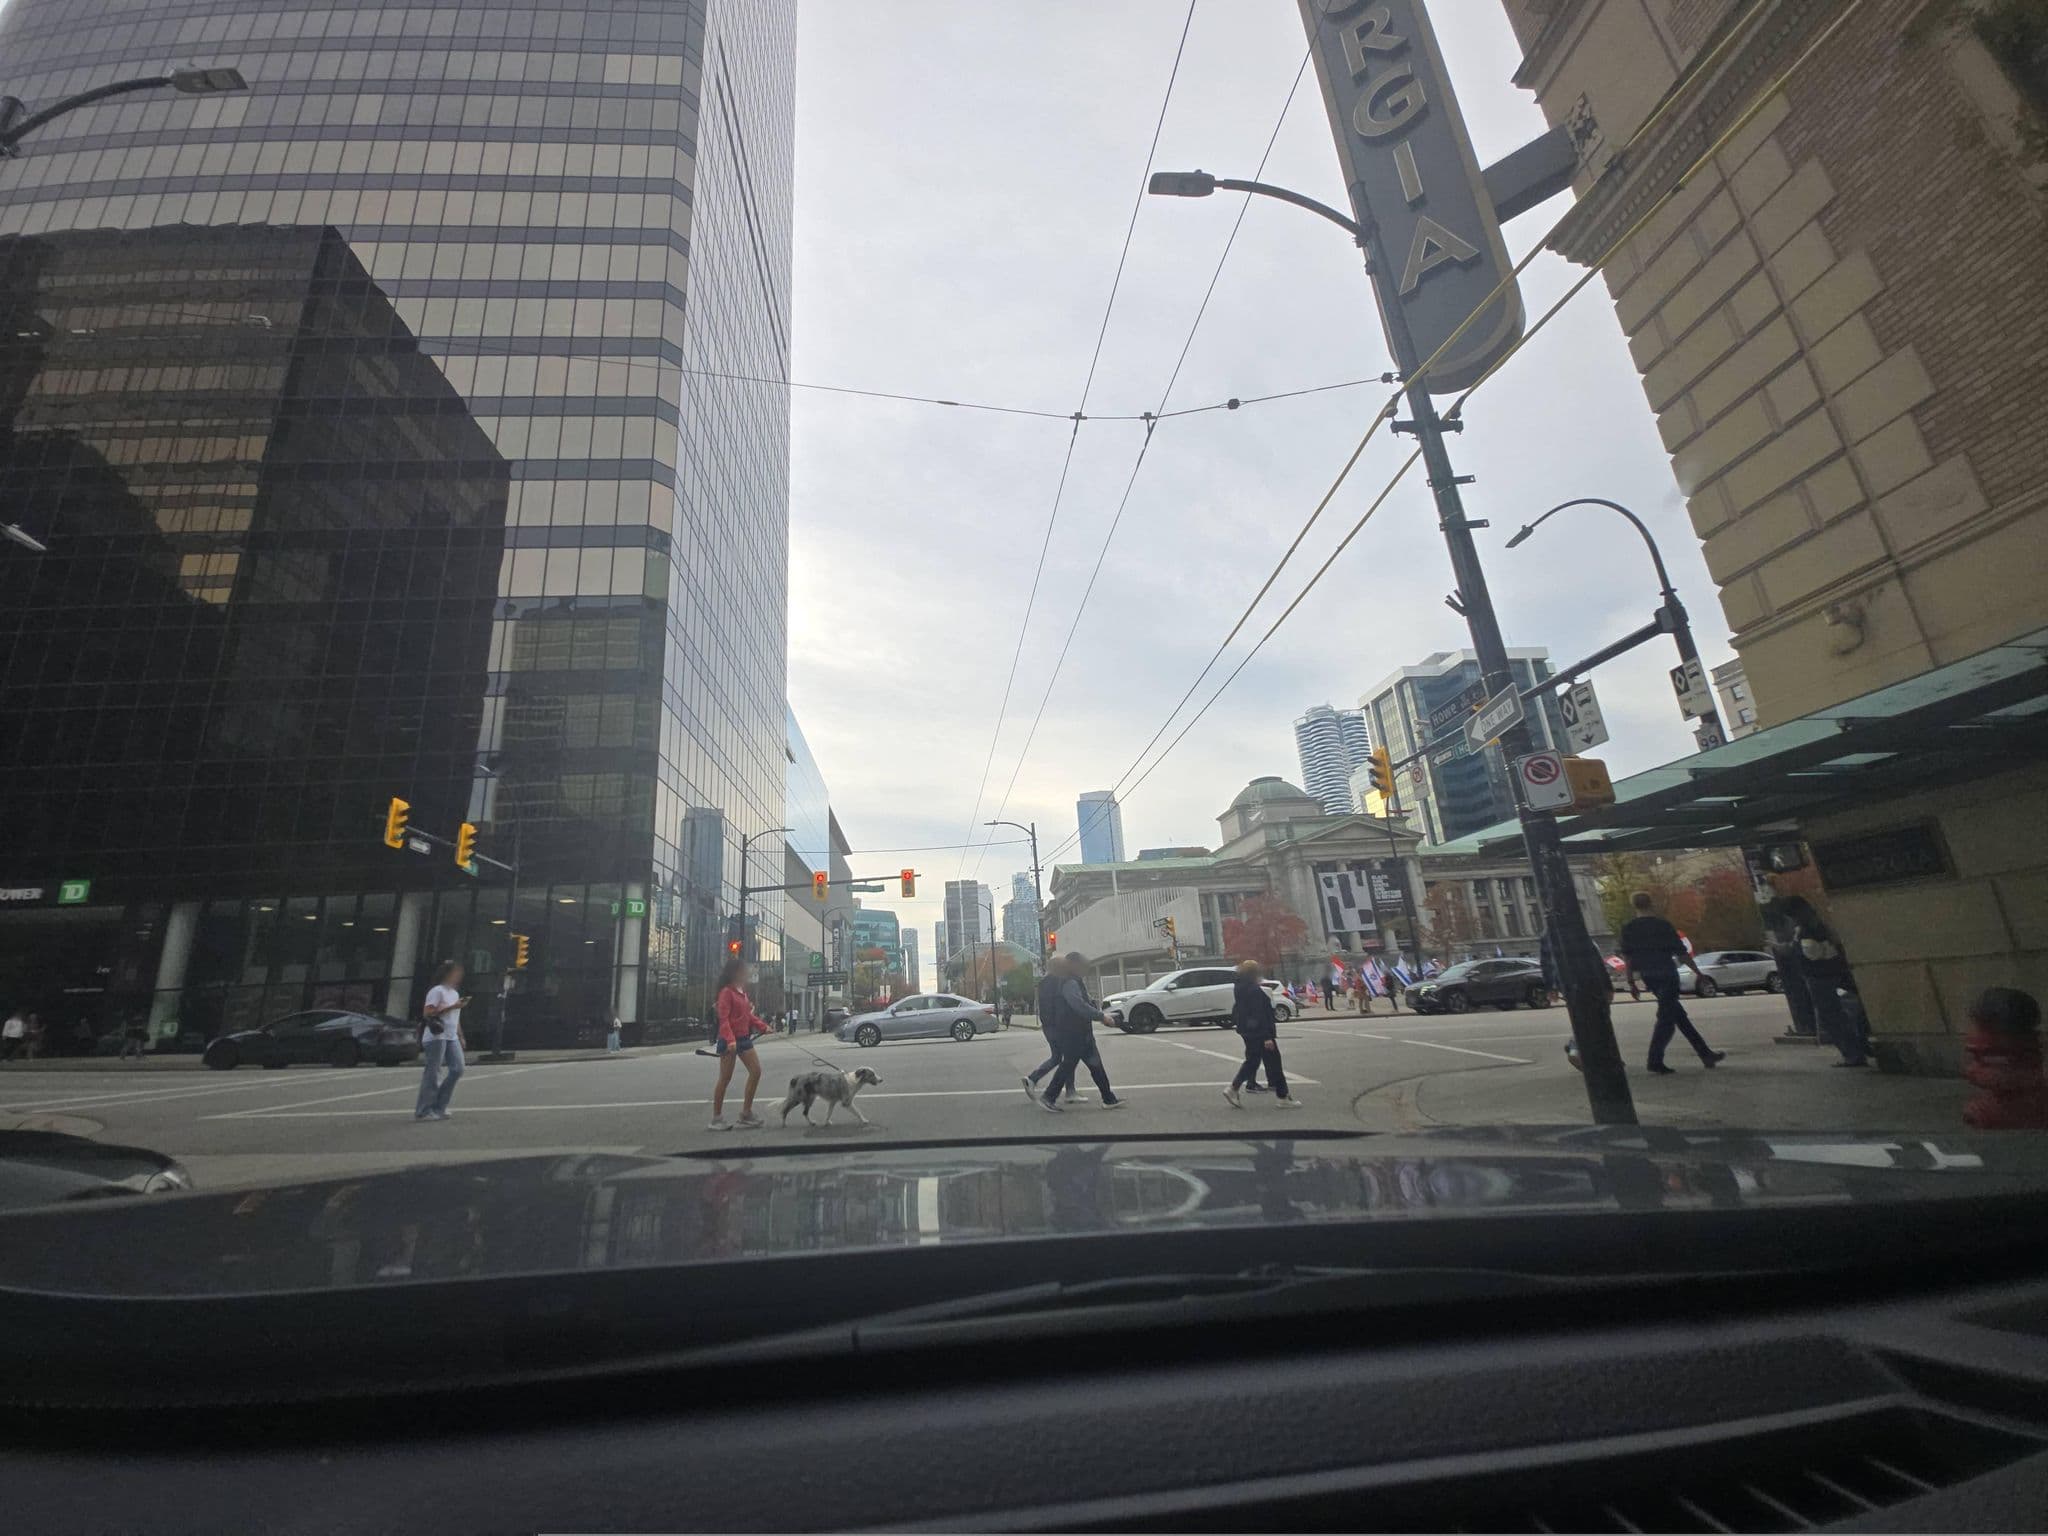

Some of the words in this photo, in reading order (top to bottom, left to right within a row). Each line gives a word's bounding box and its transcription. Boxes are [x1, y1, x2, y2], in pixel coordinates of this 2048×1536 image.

[1431, 703, 1457, 727] Howe
[62, 884, 86, 899] TD
[629, 901, 644, 913] TD
